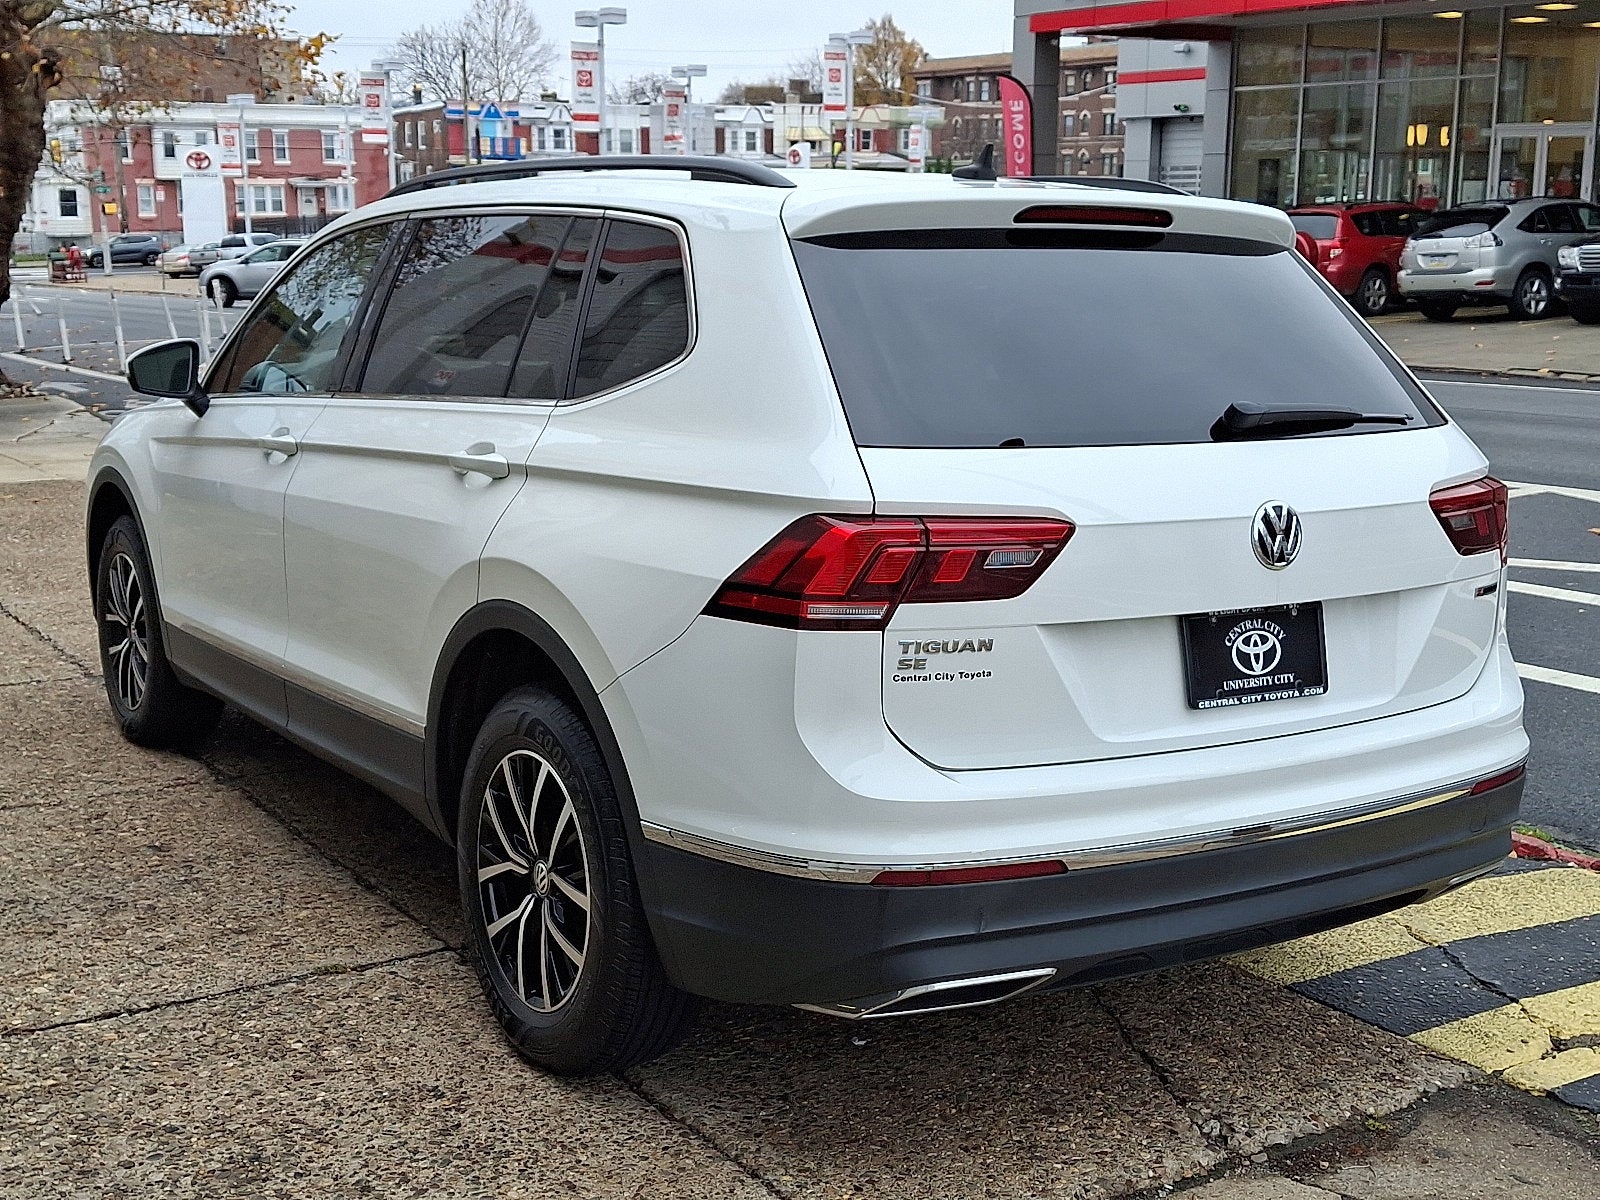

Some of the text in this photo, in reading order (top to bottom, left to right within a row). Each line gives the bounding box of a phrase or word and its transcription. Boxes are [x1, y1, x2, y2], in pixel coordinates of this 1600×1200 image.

[1224, 618, 1287, 647] CENTRAL CITY
[897, 639, 994, 655] TIGUAN
[896, 657, 928, 670] SE
[892, 670, 992, 682] Central City Toyota
[1223, 673, 1295, 691] UNIVERSITY CITY
[1198, 697, 1240, 709] CENTRAL
[1241, 694, 1262, 704] CITY
[1263, 690, 1300, 702] TOYOTA
